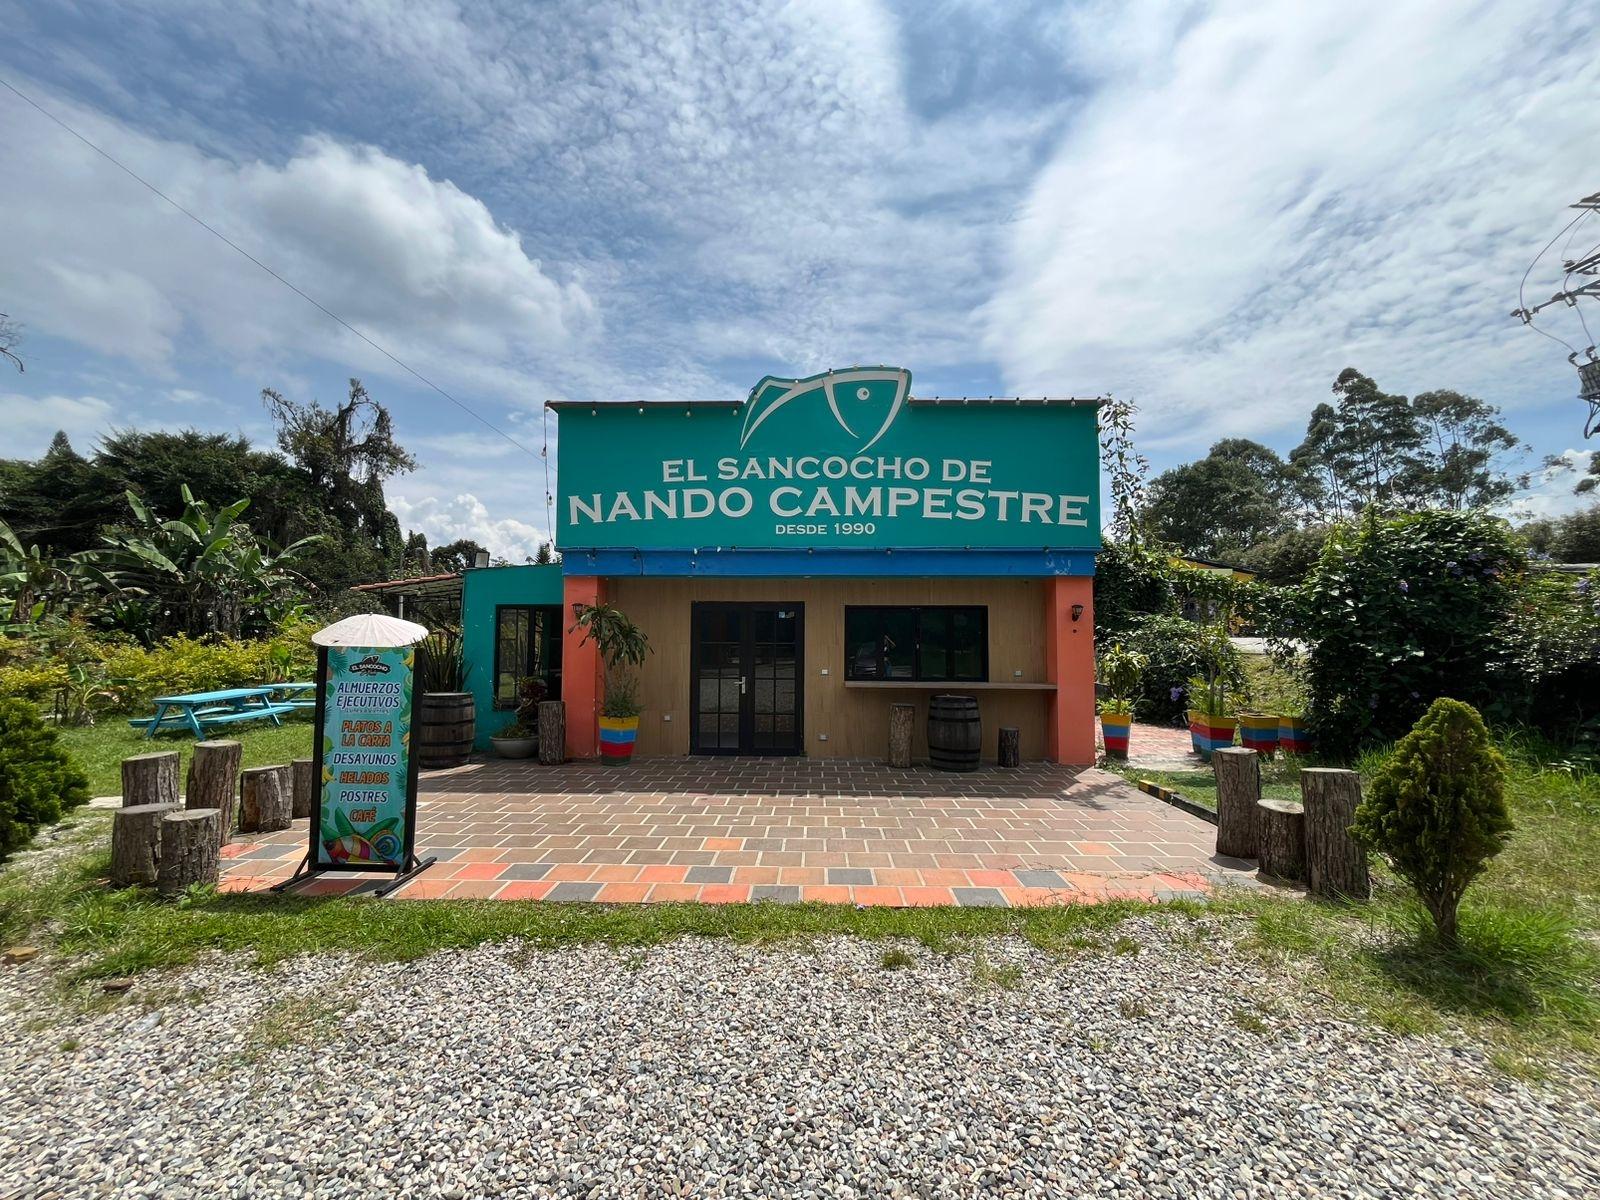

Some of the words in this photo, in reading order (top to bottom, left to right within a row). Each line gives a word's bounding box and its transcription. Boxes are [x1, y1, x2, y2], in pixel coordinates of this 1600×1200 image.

[662, 458, 707, 483] EL
[717, 456, 930, 480] SANCOCHO
[942, 458, 992, 484] DE
[568, 486, 753, 526] NANDO
[769, 486, 1090, 528] CAMPESTRE
[775, 524, 828, 535] DESDE
[834, 522, 876, 535] 1990
[337, 682, 400, 694] ALMUERZOS
[336, 695, 400, 709] EJECUTIVOS
[342, 720, 382, 733] PLATOS
[384, 721, 392, 733] A
[342, 734, 355, 746] LA
[359, 734, 391, 747] CARTA
[333, 753, 397, 765] DESAYUNOS
[340, 771, 389, 784] HELADOS
[340, 790, 388, 803] POSTRES
[350, 806, 377, 822] CAFÉ
